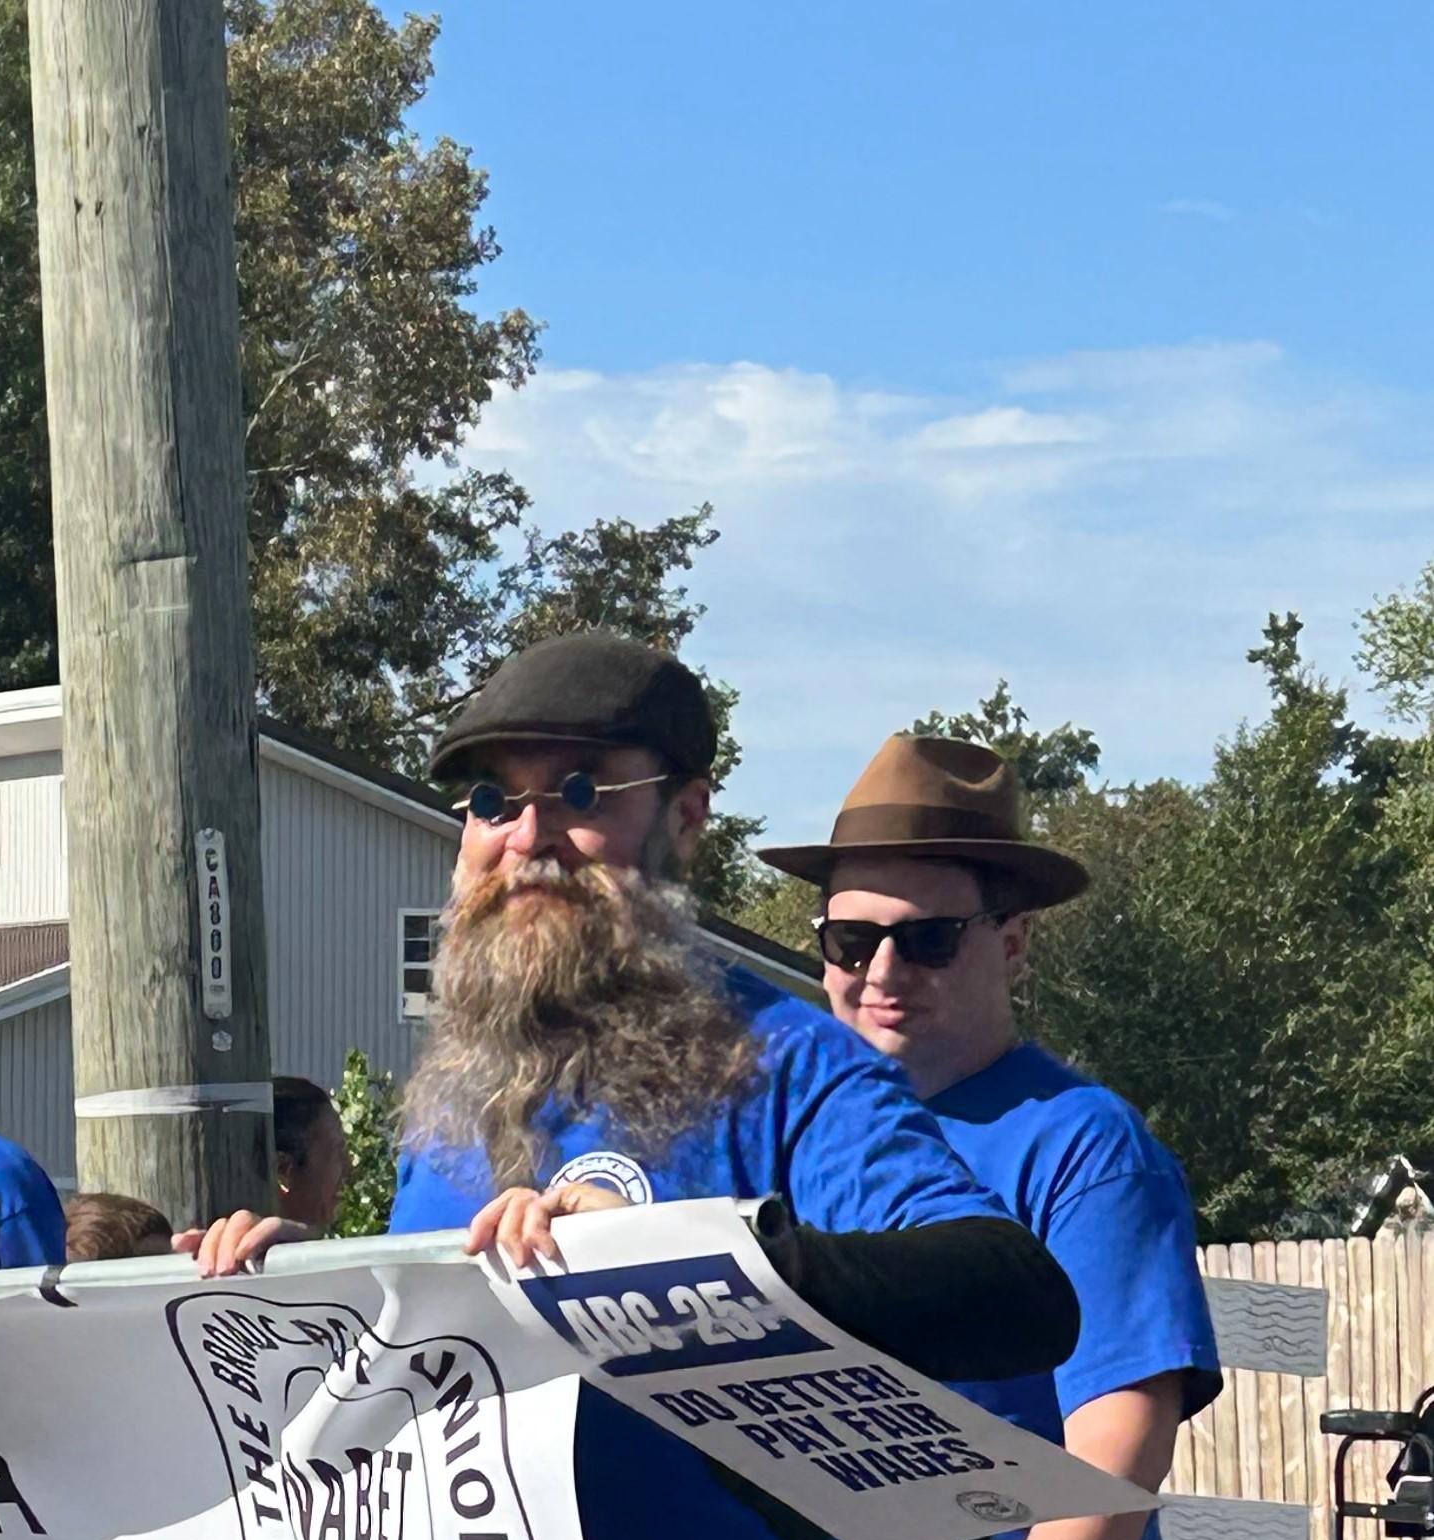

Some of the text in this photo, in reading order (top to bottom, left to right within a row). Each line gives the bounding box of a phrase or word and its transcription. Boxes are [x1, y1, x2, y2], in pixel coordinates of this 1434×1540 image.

[557, 1290, 683, 1360] ABC
[650, 1363, 921, 1428] DO BETTER!
[735, 1401, 962, 1460] PAY FAIR
[226, 1403, 284, 1530] THE
[810, 1437, 1020, 1493] WAGES.
